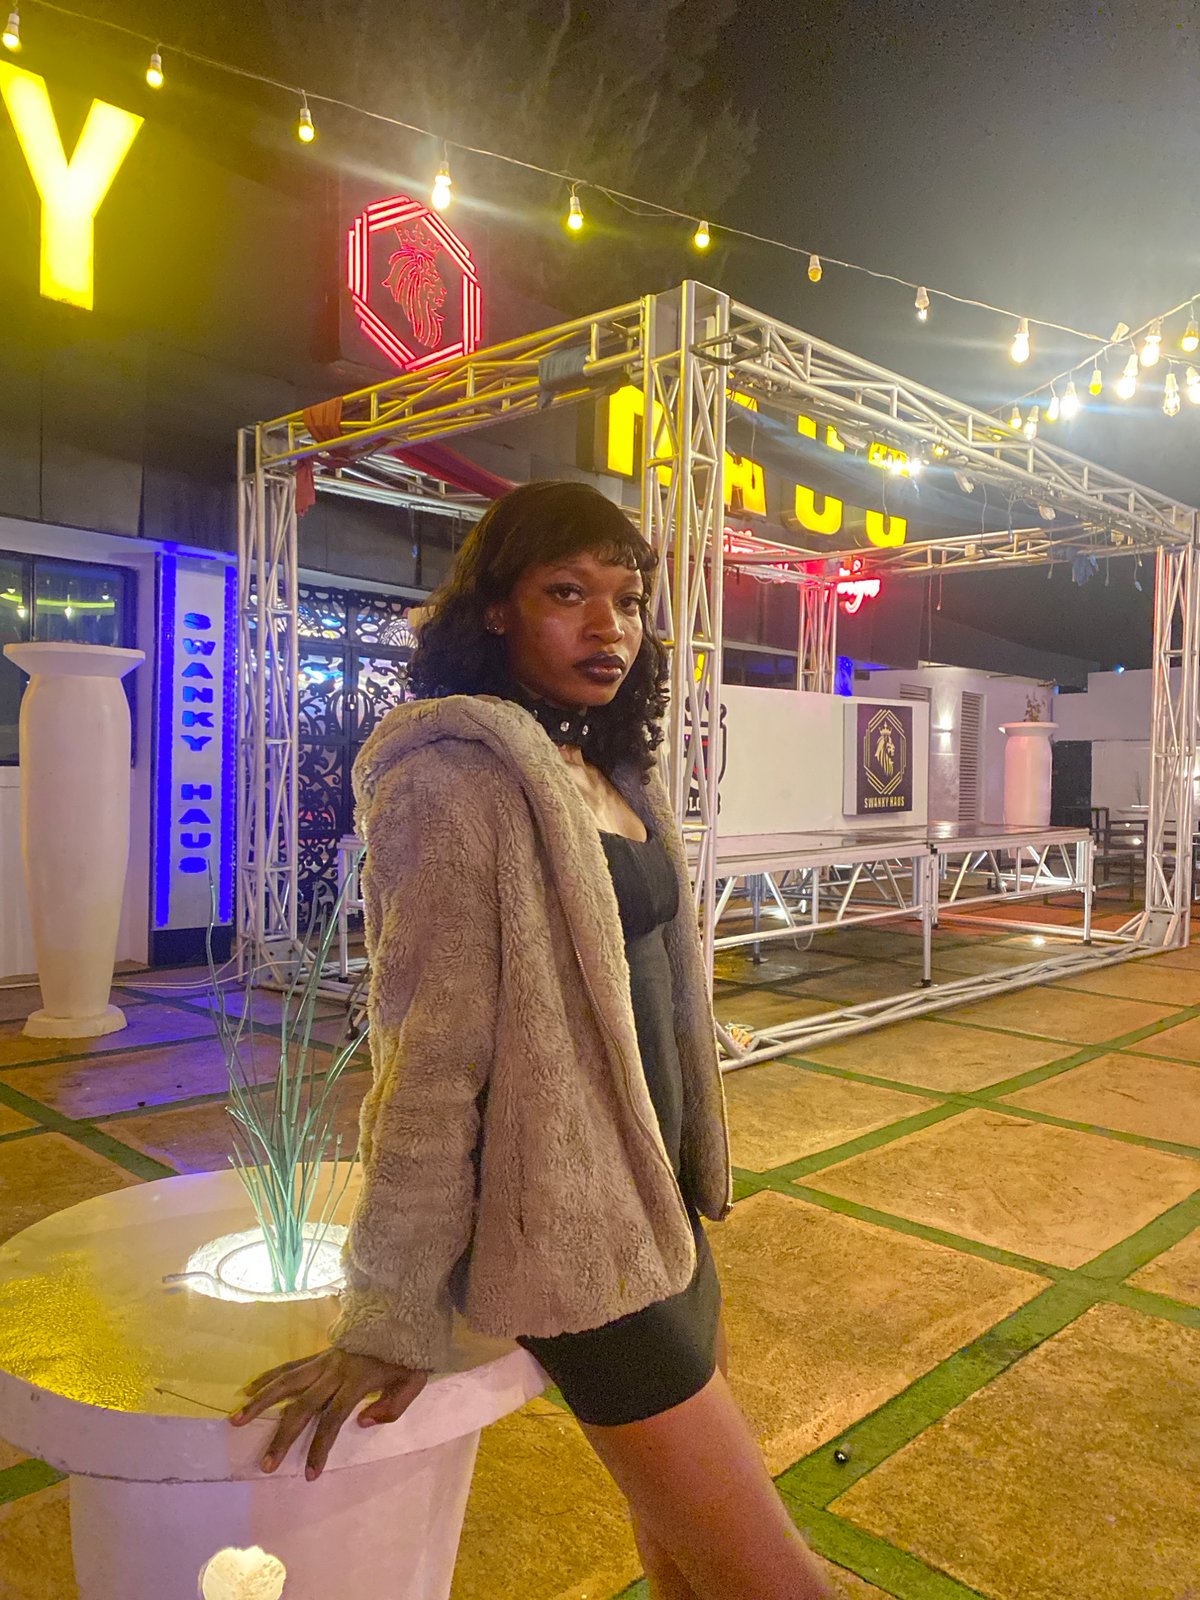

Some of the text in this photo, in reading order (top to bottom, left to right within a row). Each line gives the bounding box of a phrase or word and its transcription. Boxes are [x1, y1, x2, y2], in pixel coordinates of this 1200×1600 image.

[180, 612, 216, 752] SWANKY
[178, 783, 213, 874] HAUS
[864, 795, 905, 808] SWANKY HAUS
